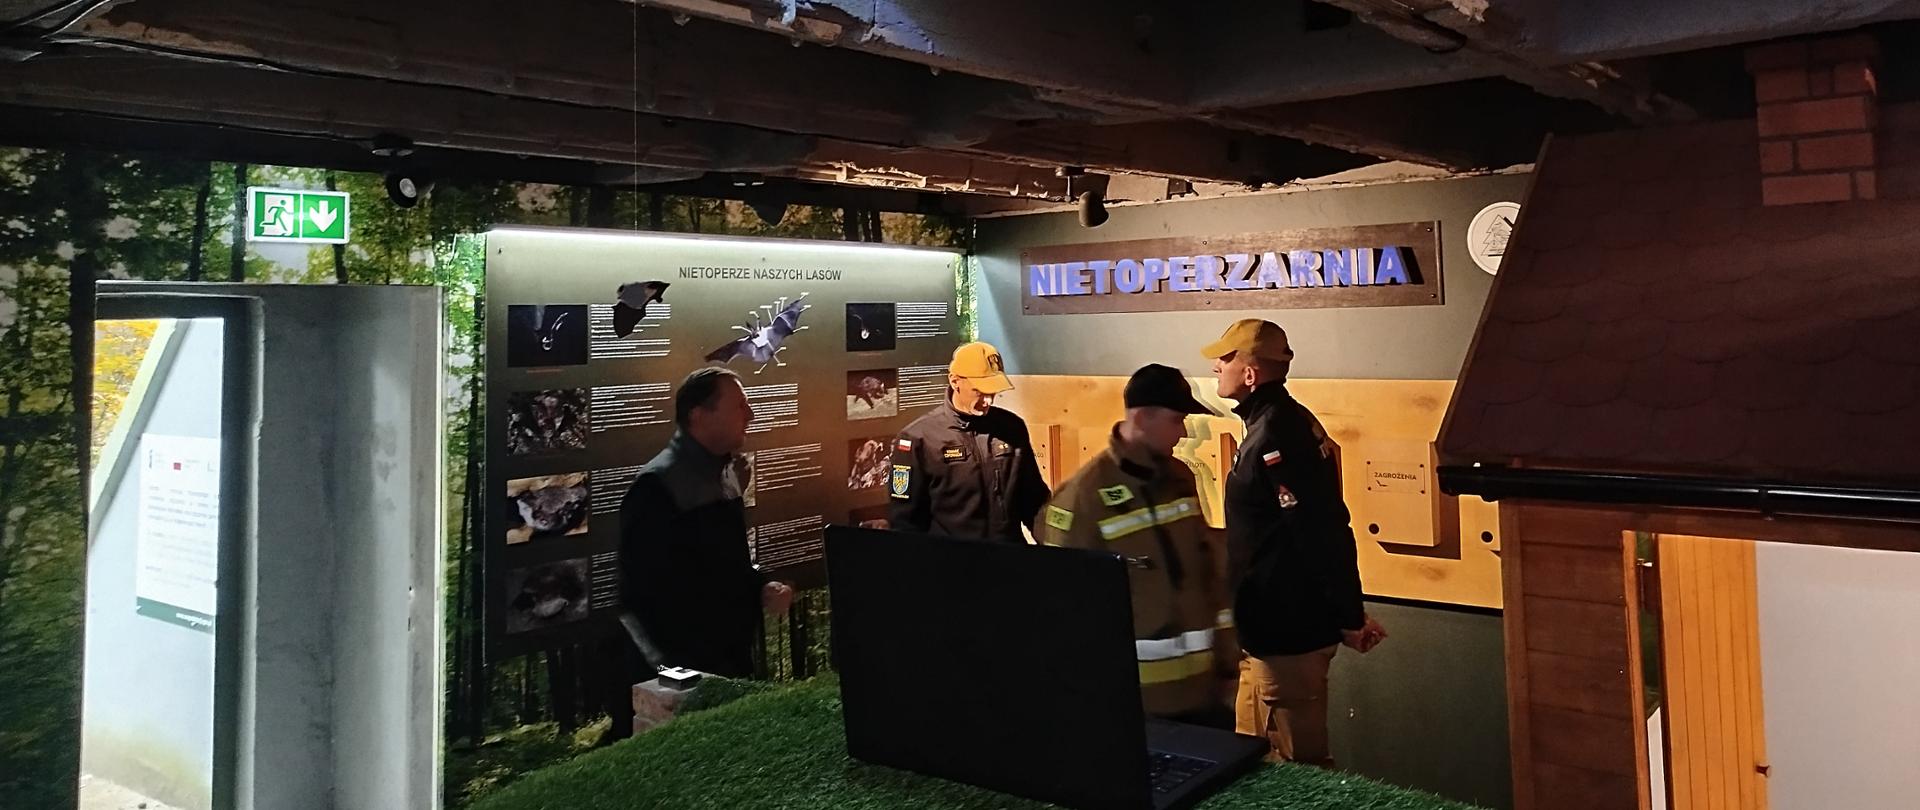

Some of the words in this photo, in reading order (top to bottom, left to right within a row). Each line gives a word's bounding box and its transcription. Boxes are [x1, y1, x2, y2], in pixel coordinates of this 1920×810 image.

[679, 267, 750, 279] NIETOPERZE
[753, 268, 802, 280] NASZYCH
[806, 267, 841, 281] LASÓW
[1030, 246, 1409, 297] NIETOPERZARNIA
